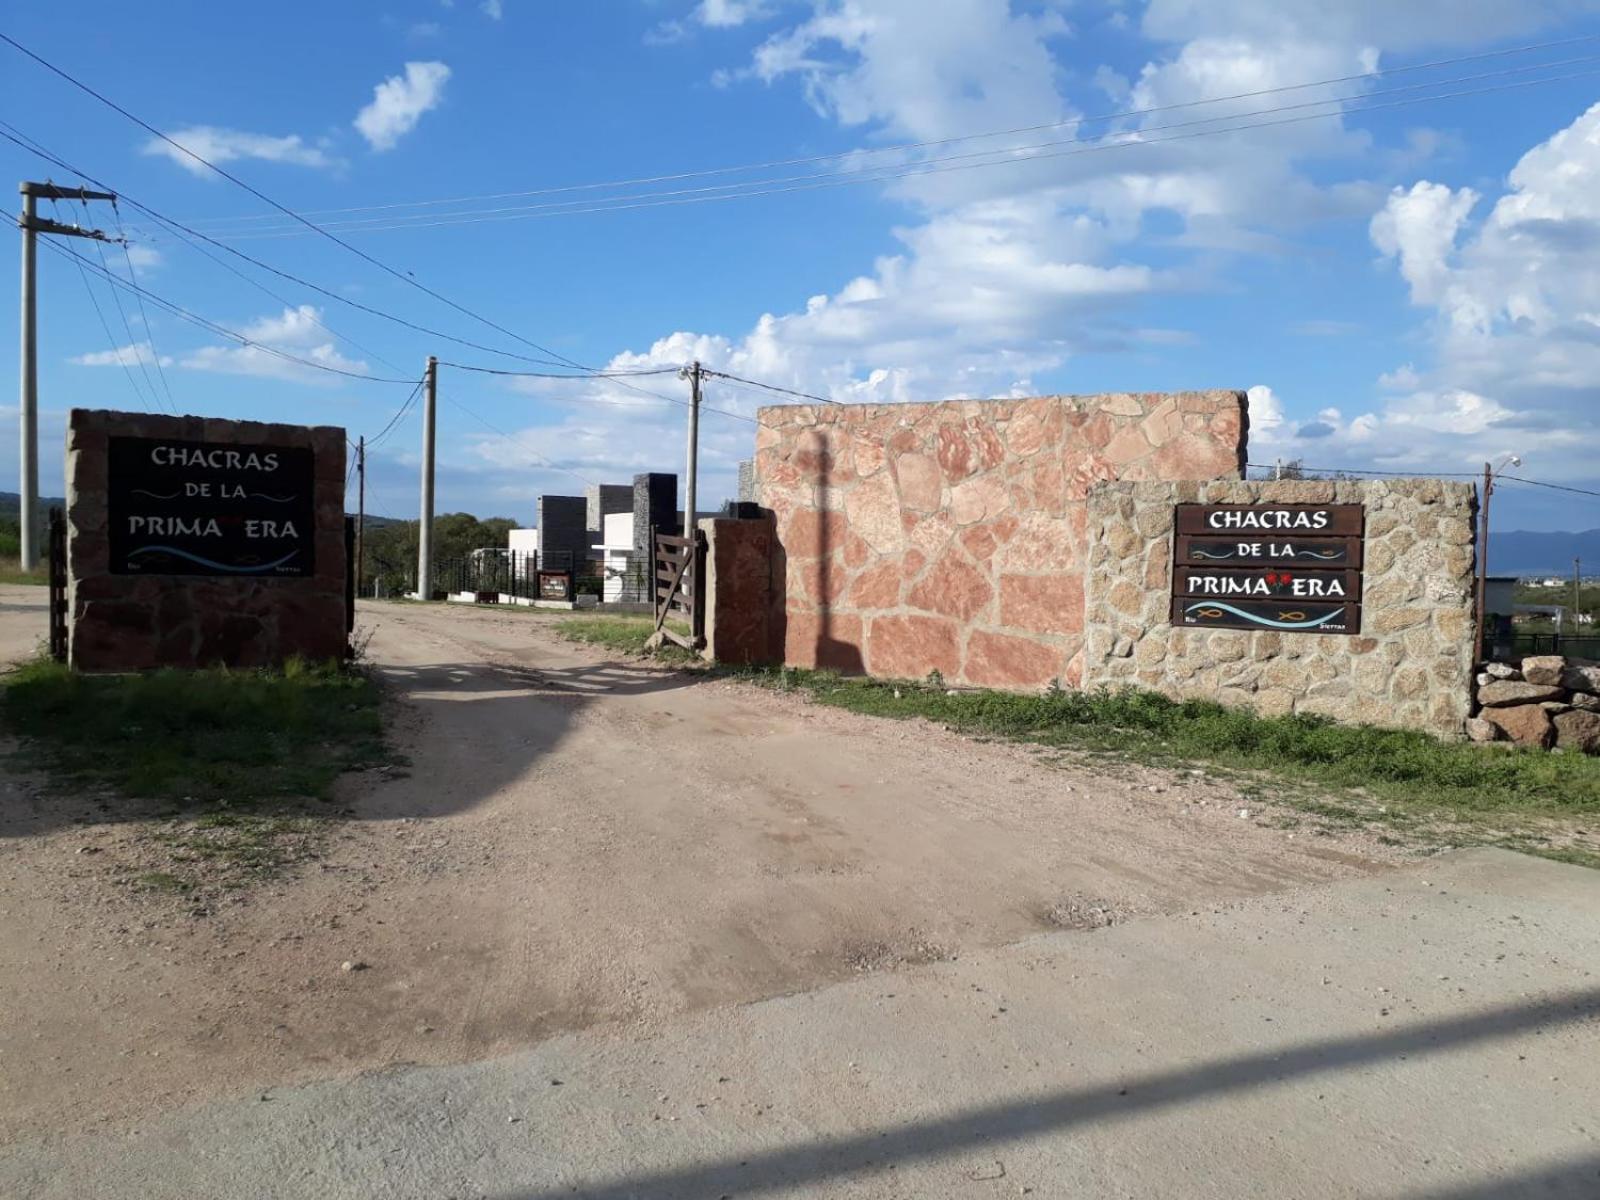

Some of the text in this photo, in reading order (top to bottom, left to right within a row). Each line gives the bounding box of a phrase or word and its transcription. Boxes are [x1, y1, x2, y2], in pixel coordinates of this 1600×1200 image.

[151, 446, 279, 471] CHACRAS
[185, 483, 247, 498] DE LA
[128, 516, 299, 538] PRIMAERA
[1209, 510, 1328, 529] CHACRAS
[1237, 543, 1295, 557] DE LA
